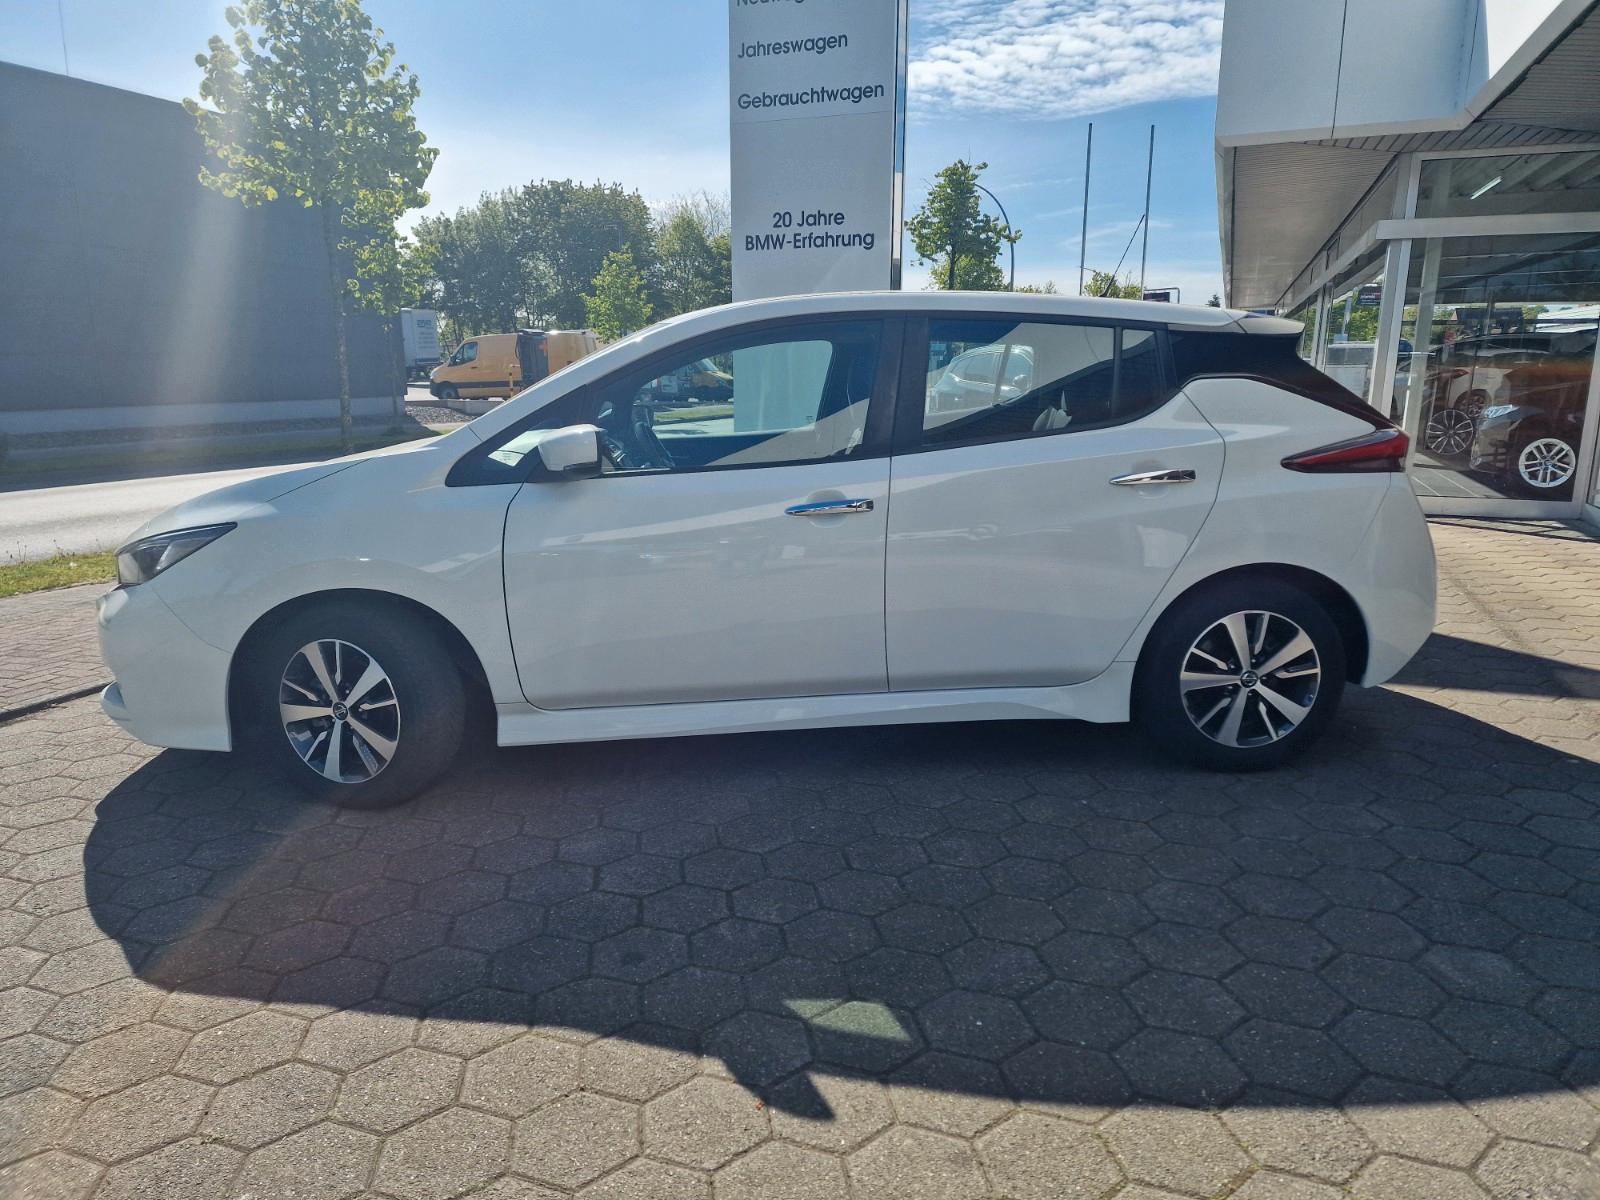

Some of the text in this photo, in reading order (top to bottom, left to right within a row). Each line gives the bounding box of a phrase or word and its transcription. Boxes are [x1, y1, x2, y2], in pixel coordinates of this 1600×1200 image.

[737, 34, 848, 58] Jahreswagen
[737, 84, 885, 109] Gebrauchtwagen
[773, 210, 845, 228] 20 Jahre
[745, 231, 875, 251] BMW-Erfahrung
